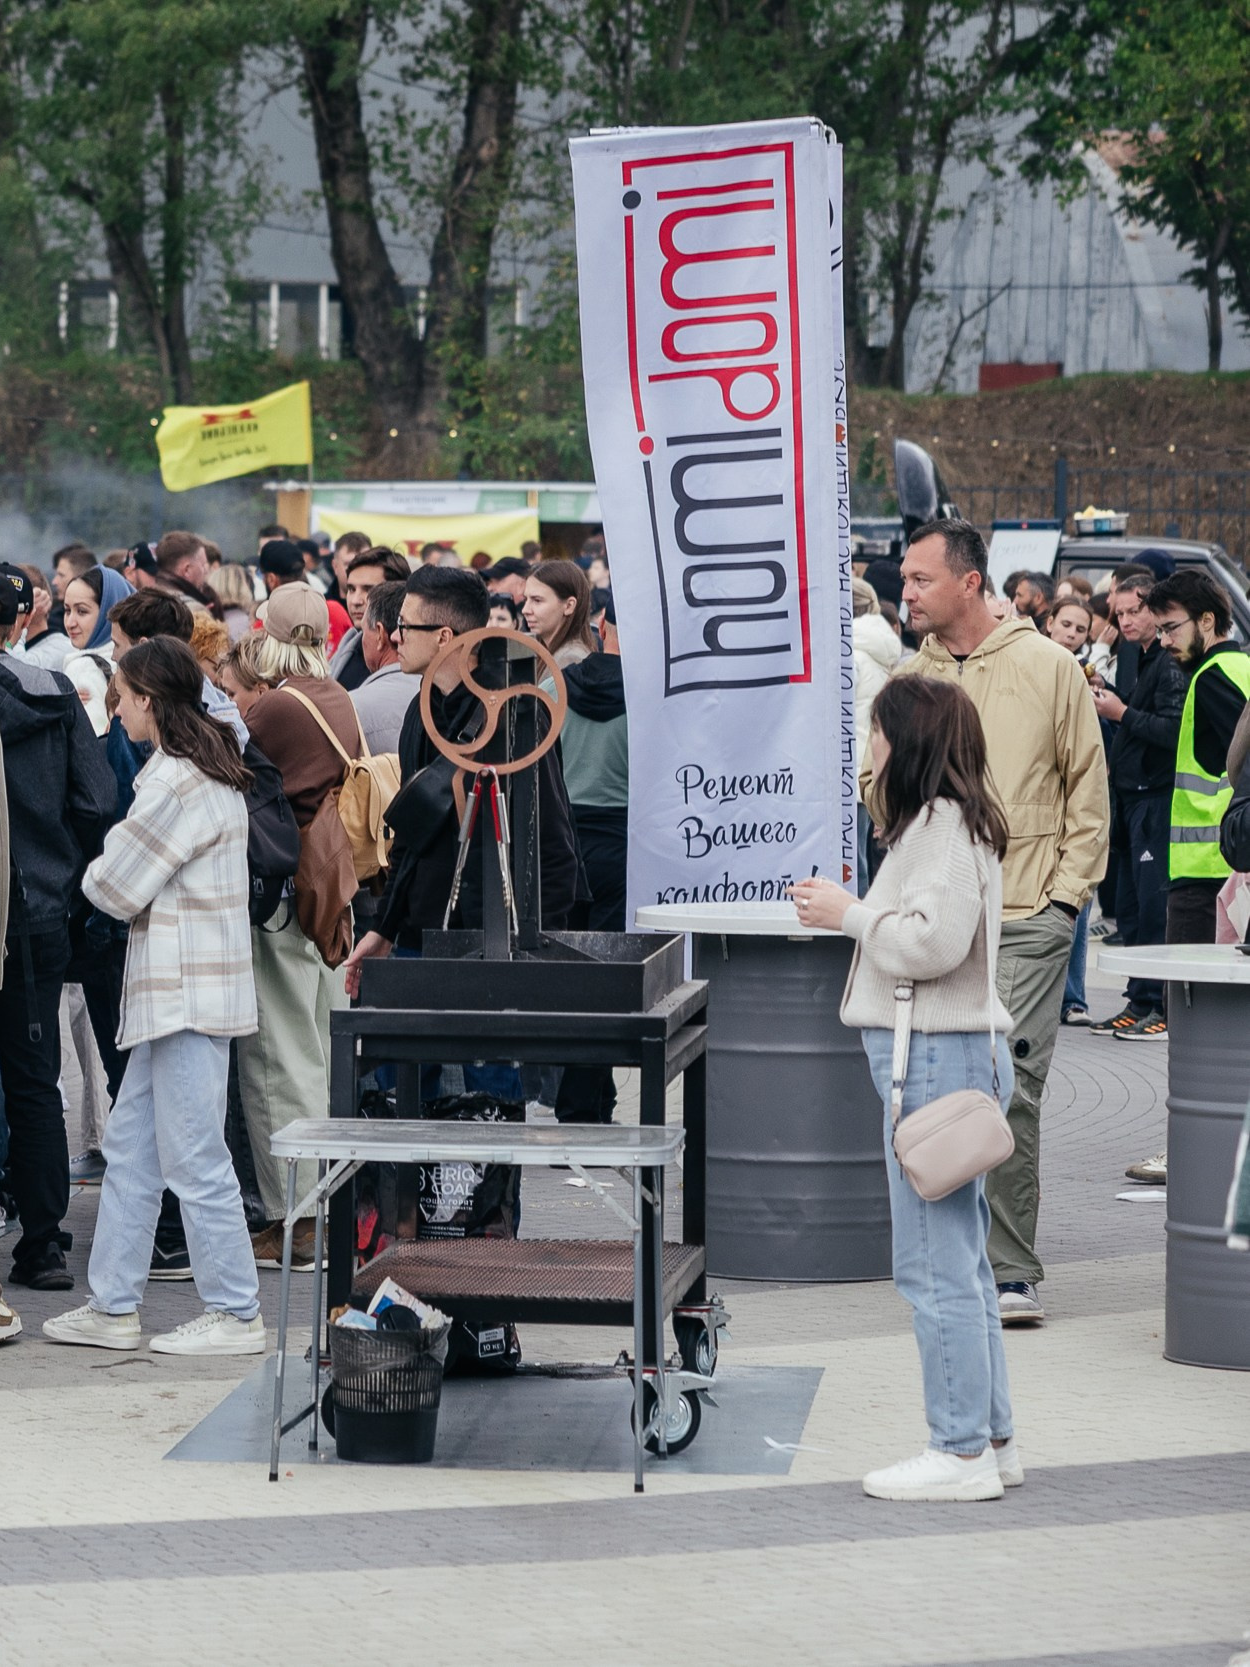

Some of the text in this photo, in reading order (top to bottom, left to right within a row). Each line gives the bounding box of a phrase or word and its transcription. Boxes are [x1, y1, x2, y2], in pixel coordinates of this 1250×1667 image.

[622, 178, 792, 665] homidomi
[675, 763, 795, 806] Рецепт
[676, 815, 798, 859] Вашего
[431, 1183, 474, 1197] COAL
[483, 1343, 491, 1352] 10
